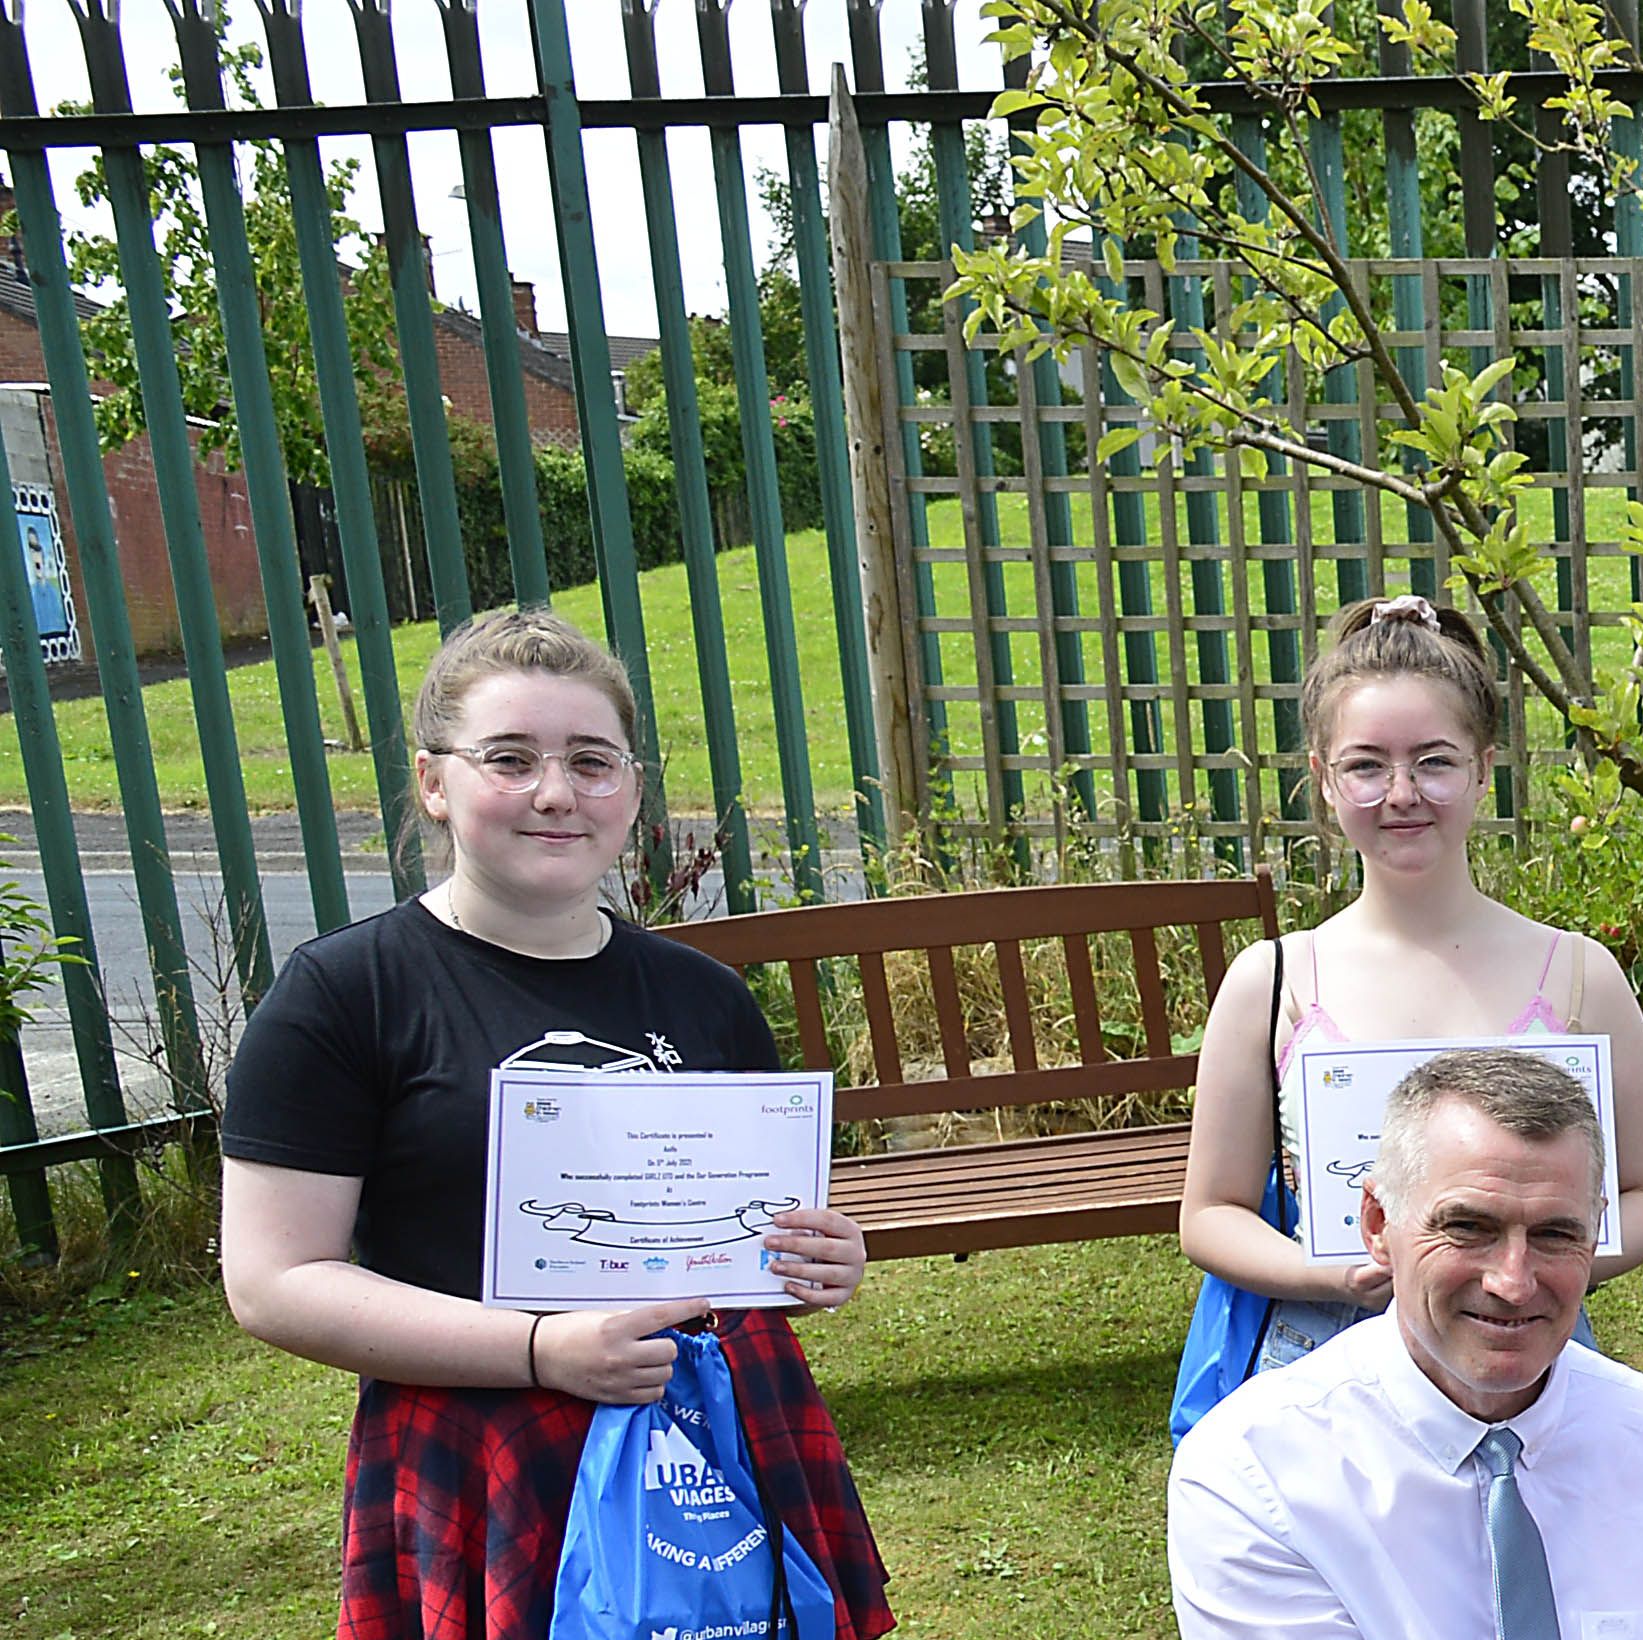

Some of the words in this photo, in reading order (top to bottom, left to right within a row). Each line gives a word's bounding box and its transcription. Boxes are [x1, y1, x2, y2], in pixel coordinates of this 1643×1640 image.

[761, 1105, 814, 1115] footprints
[647, 1526, 696, 1567] AKING
[698, 1555, 712, 1571] A
